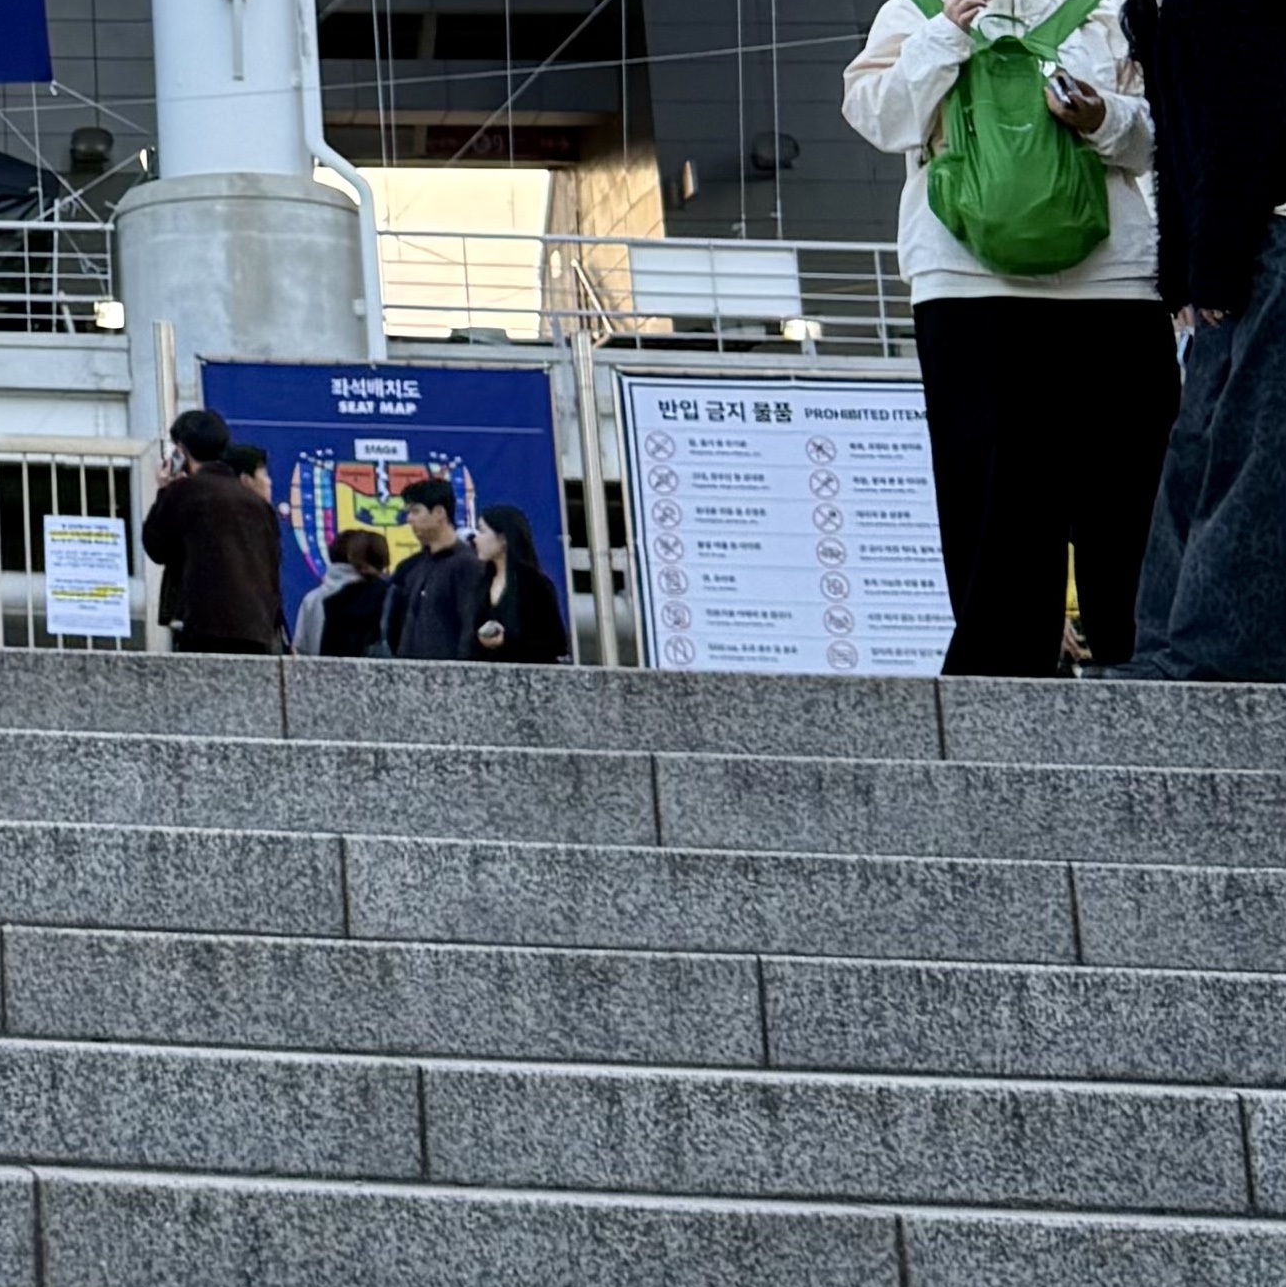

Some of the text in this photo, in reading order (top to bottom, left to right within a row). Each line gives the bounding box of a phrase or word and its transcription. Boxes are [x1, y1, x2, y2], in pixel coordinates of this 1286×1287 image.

[338, 400, 418, 416] SEAT MAP
[658, 399, 698, 422] 반입
[705, 400, 746, 422] 금지
